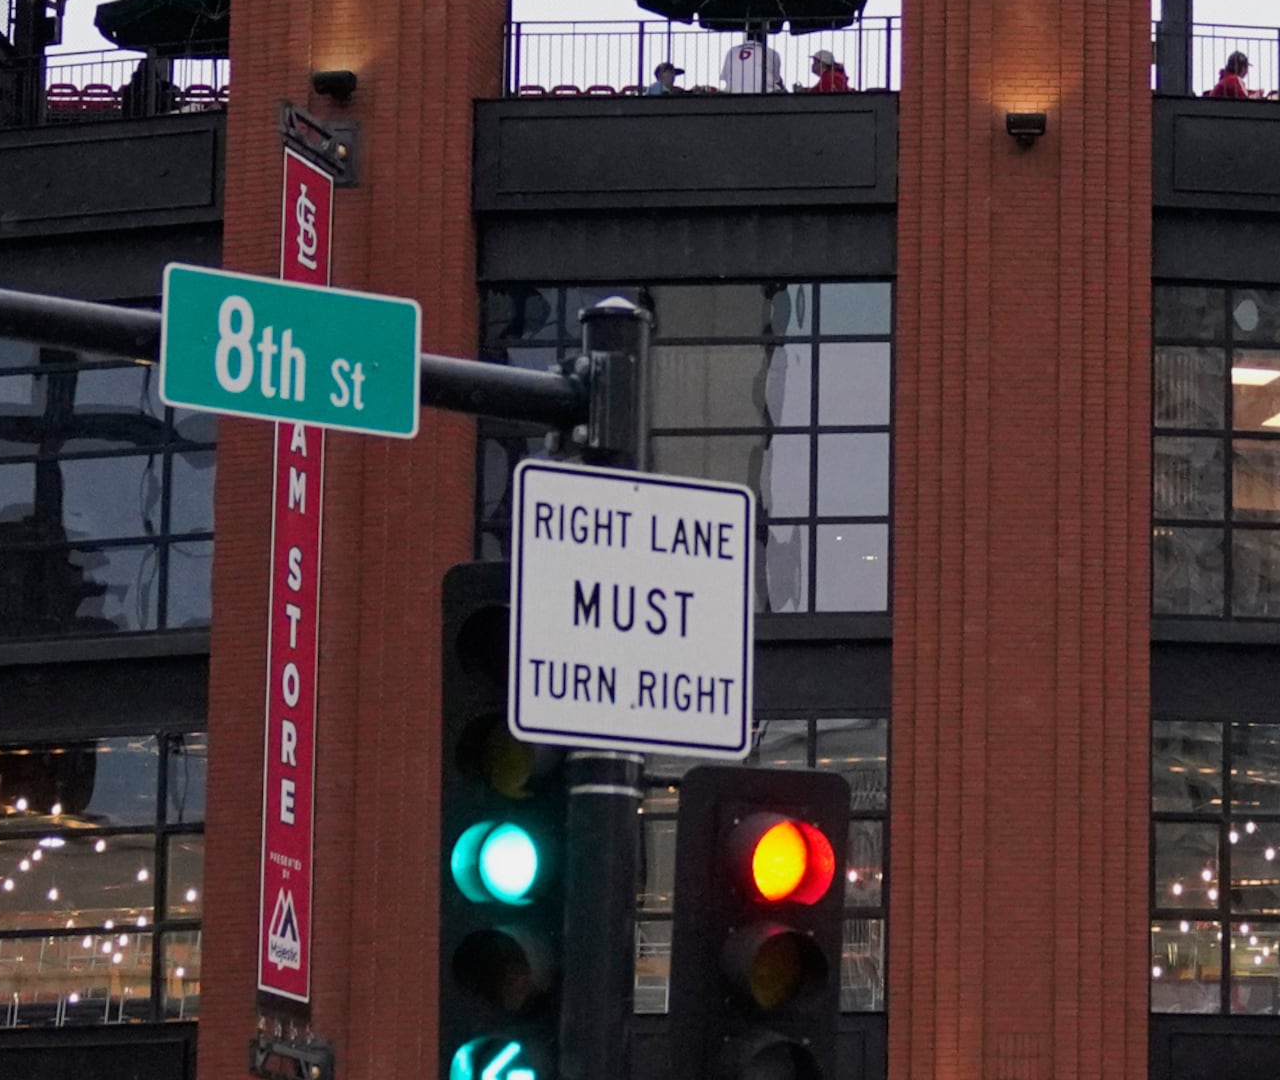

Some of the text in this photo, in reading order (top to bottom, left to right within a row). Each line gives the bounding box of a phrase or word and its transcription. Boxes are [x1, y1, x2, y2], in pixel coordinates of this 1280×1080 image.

[215, 295, 366, 411] 8th St
[534, 501, 734, 560] RIGHT LANE
[279, 423, 309, 827] AM STORE
[573, 579, 694, 638] MUST
[529, 659, 735, 716] TURN RIGHT
